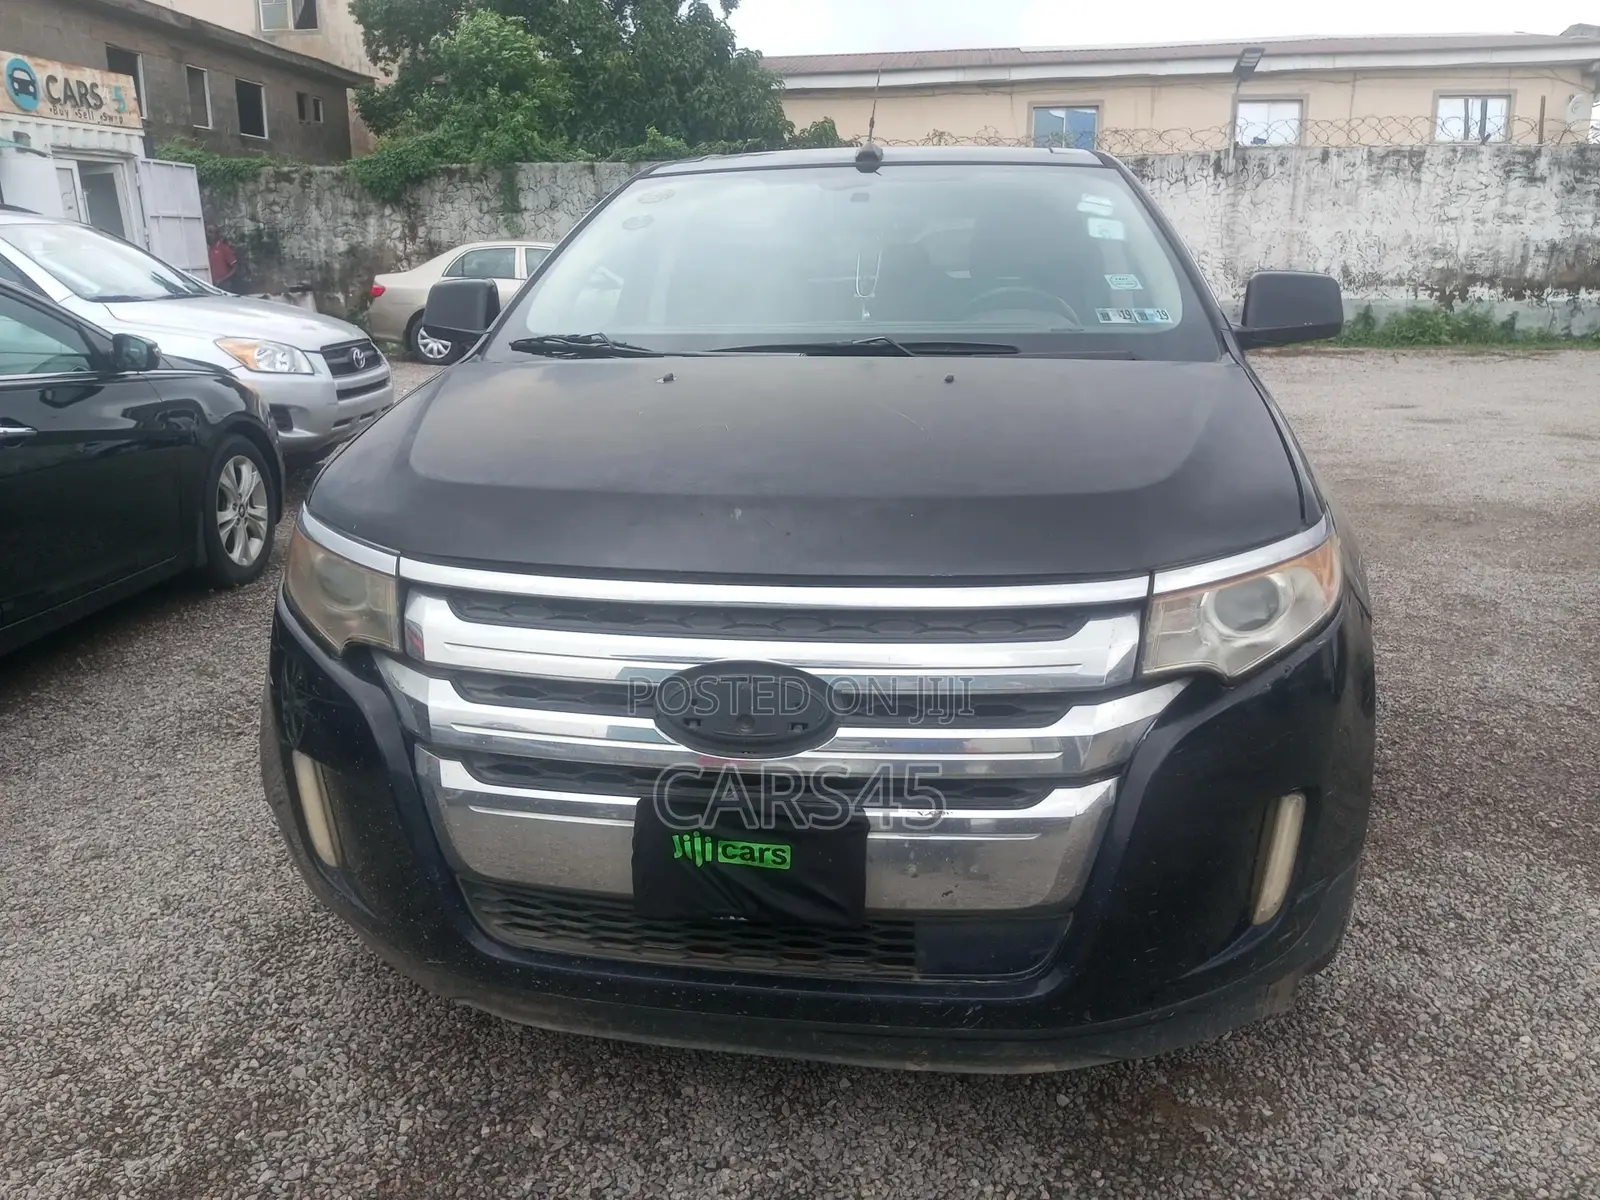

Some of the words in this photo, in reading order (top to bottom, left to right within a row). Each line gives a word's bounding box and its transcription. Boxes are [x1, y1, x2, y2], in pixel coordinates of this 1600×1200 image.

[45, 75, 103, 110] CARS
[77, 109, 95, 120] Sell
[721, 843, 788, 866] cars
